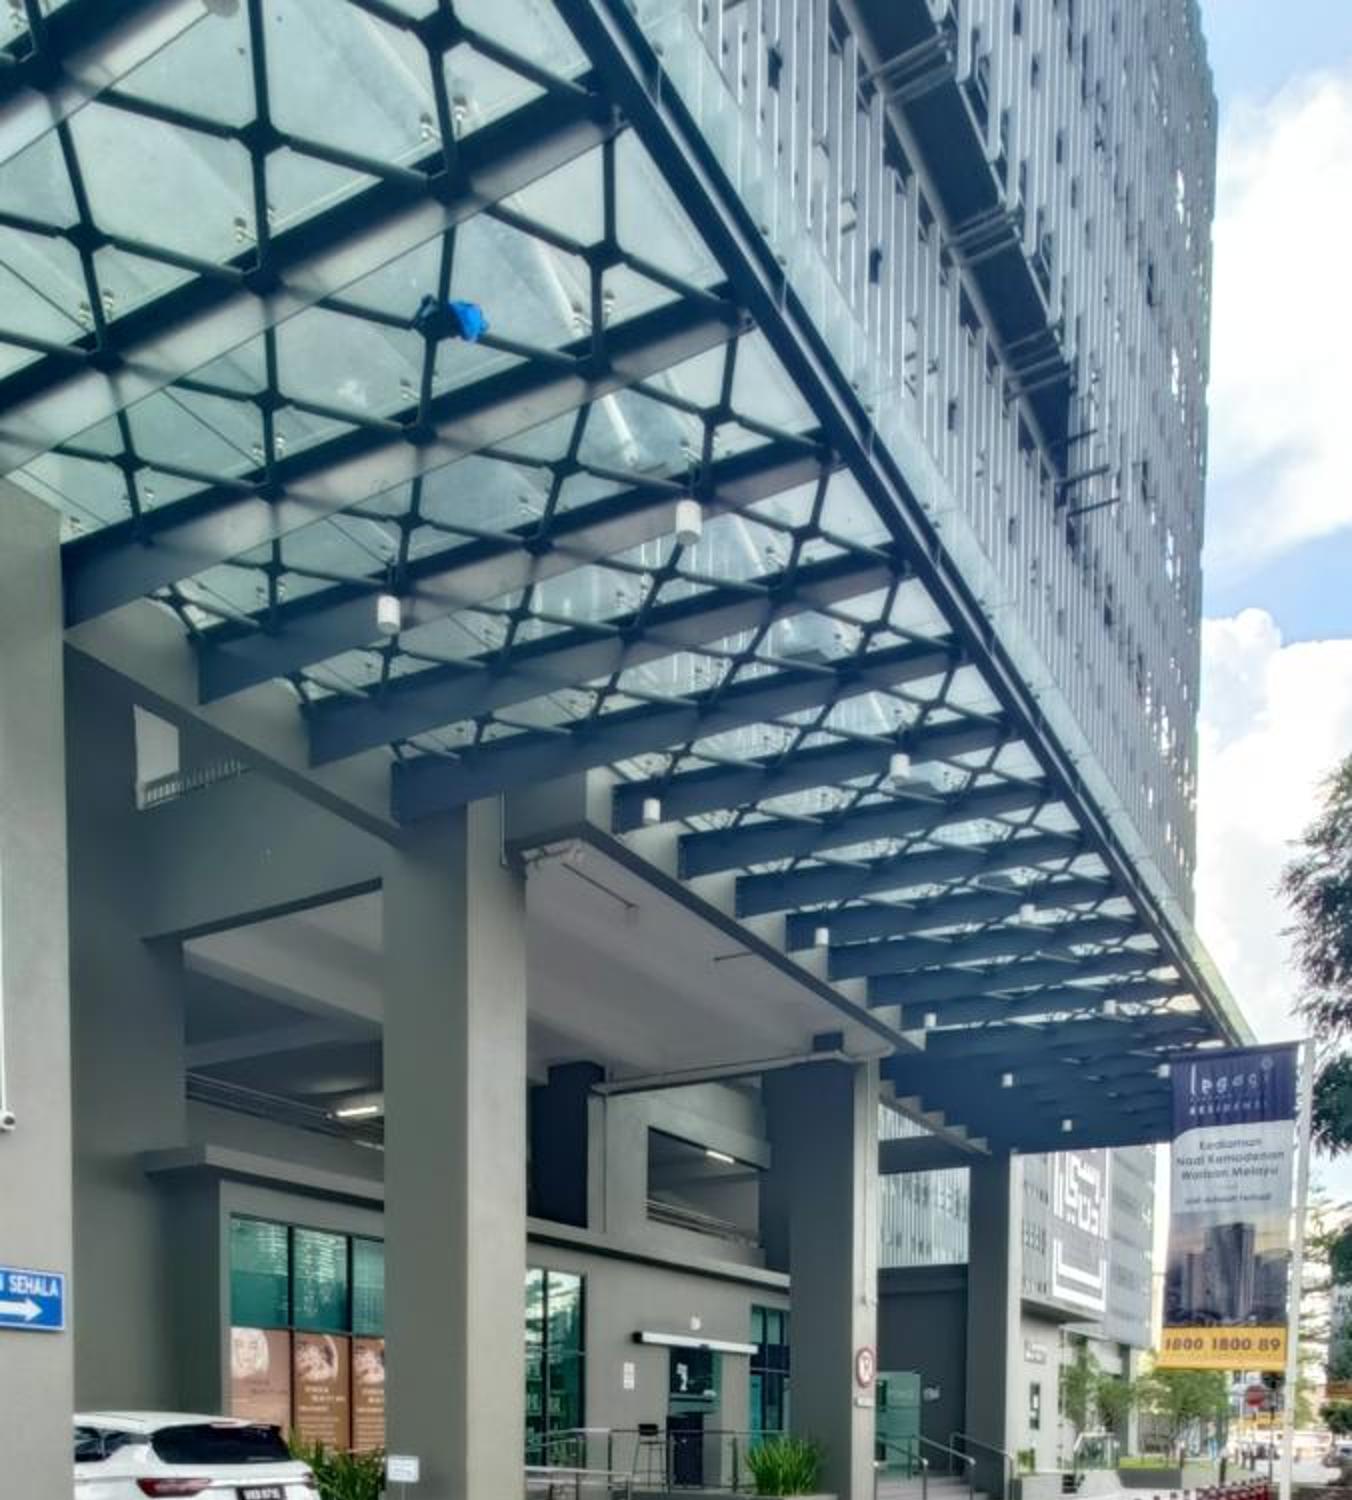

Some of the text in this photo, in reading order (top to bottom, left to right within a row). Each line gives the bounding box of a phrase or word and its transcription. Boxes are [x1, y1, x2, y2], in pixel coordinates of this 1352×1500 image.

[1232, 1167, 1279, 1178] Melayu
[9, 1275, 59, 1296] SEHALA
[1165, 1336, 1281, 1351] 1800 1800 89
